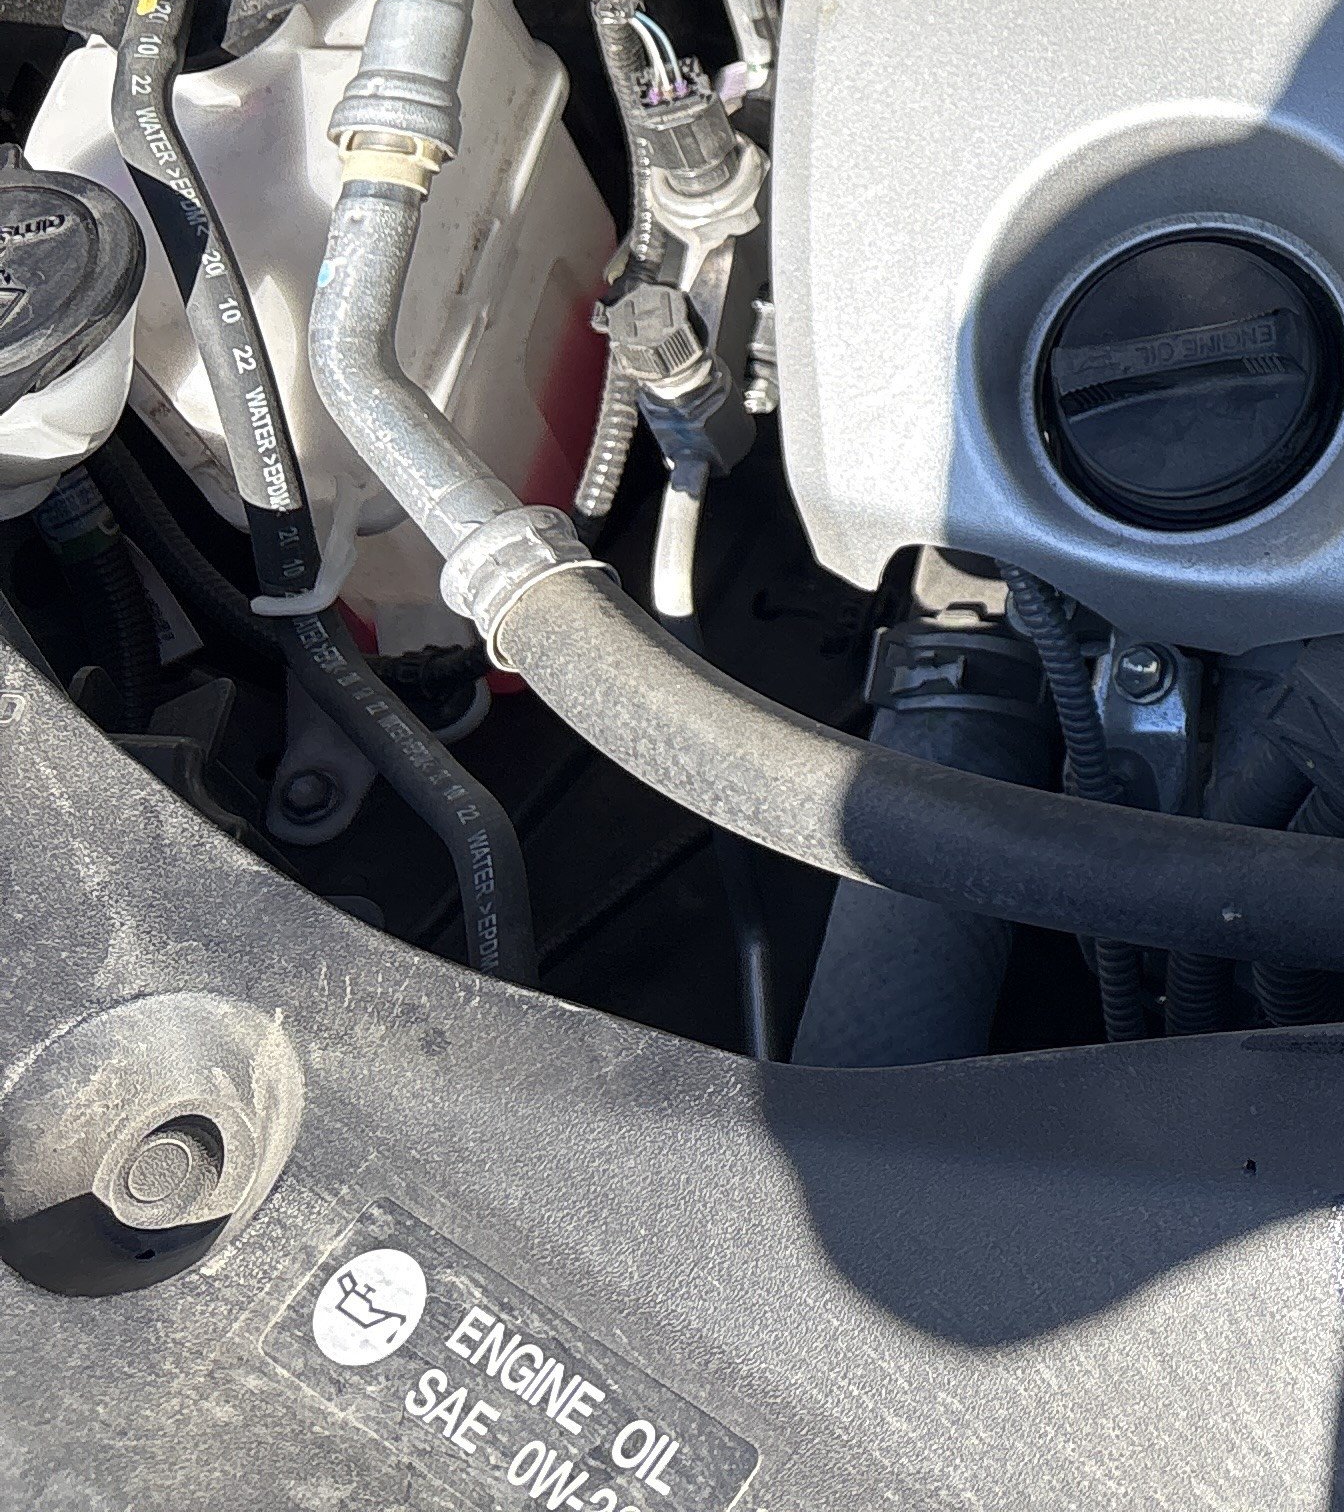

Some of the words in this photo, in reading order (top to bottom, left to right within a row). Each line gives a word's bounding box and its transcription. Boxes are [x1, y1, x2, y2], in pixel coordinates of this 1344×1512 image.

[131, 74, 152, 96] 22
[135, 105, 177, 166] WATER
[218, 297, 242, 324] 10
[1134, 340, 1176, 368] OIL
[1181, 322, 1276, 359] ENGINE
[232, 344, 257, 375] 22
[245, 385, 277, 454] WATER
[456, 804, 481, 826] 22
[467, 828, 495, 901] WATER
[445, 1305, 606, 1436] ENGINE
[611, 1419, 680, 1496] OIL
[404, 1368, 501, 1455] SAE
[506, 1440, 644, 1512] 0W-2
